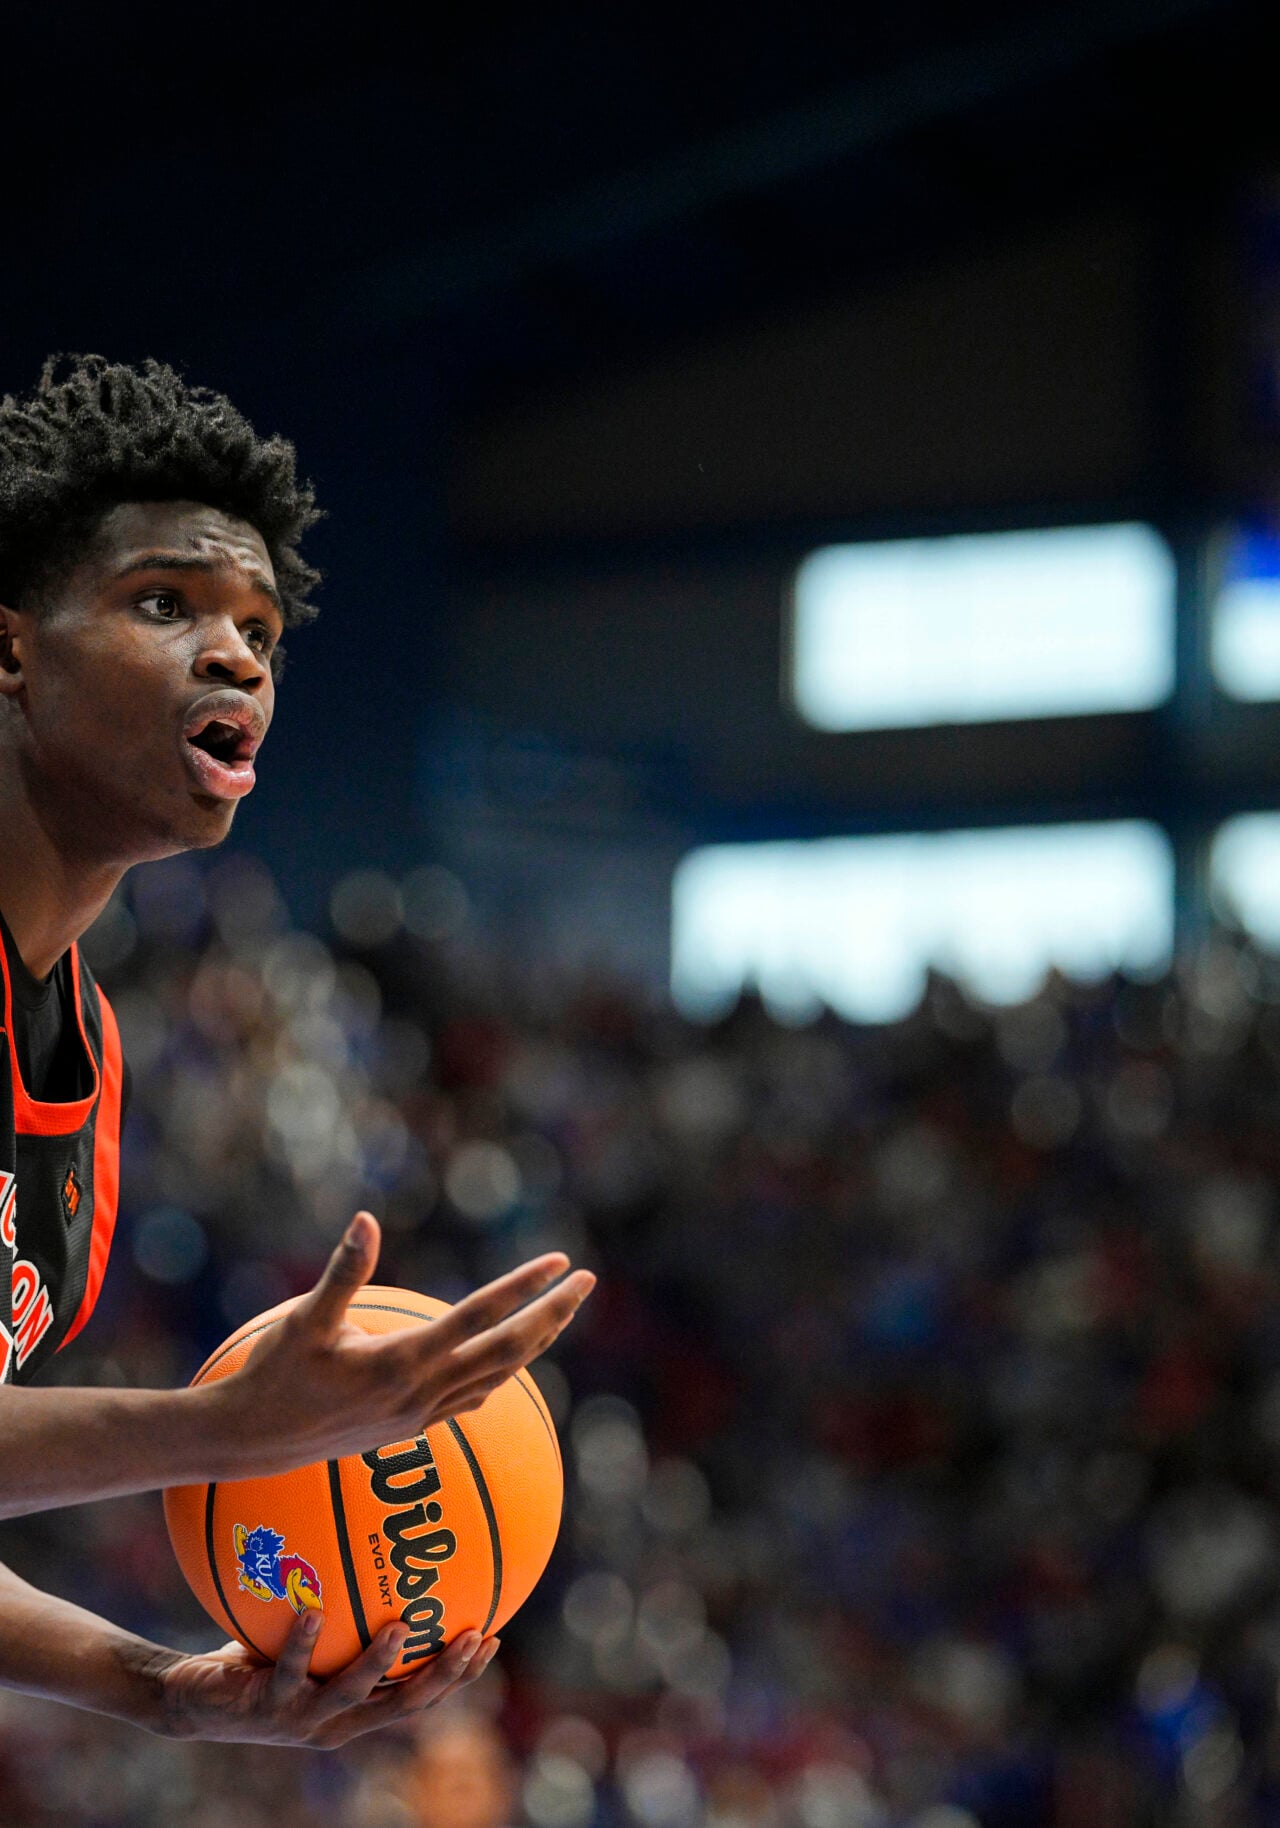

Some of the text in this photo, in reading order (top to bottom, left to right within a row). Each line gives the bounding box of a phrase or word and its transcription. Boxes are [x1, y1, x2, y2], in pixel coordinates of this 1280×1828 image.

[256, 1552, 273, 1577] KU
[360, 1431, 458, 1666] Wilson
[368, 1533, 393, 1607] EVO NXT
